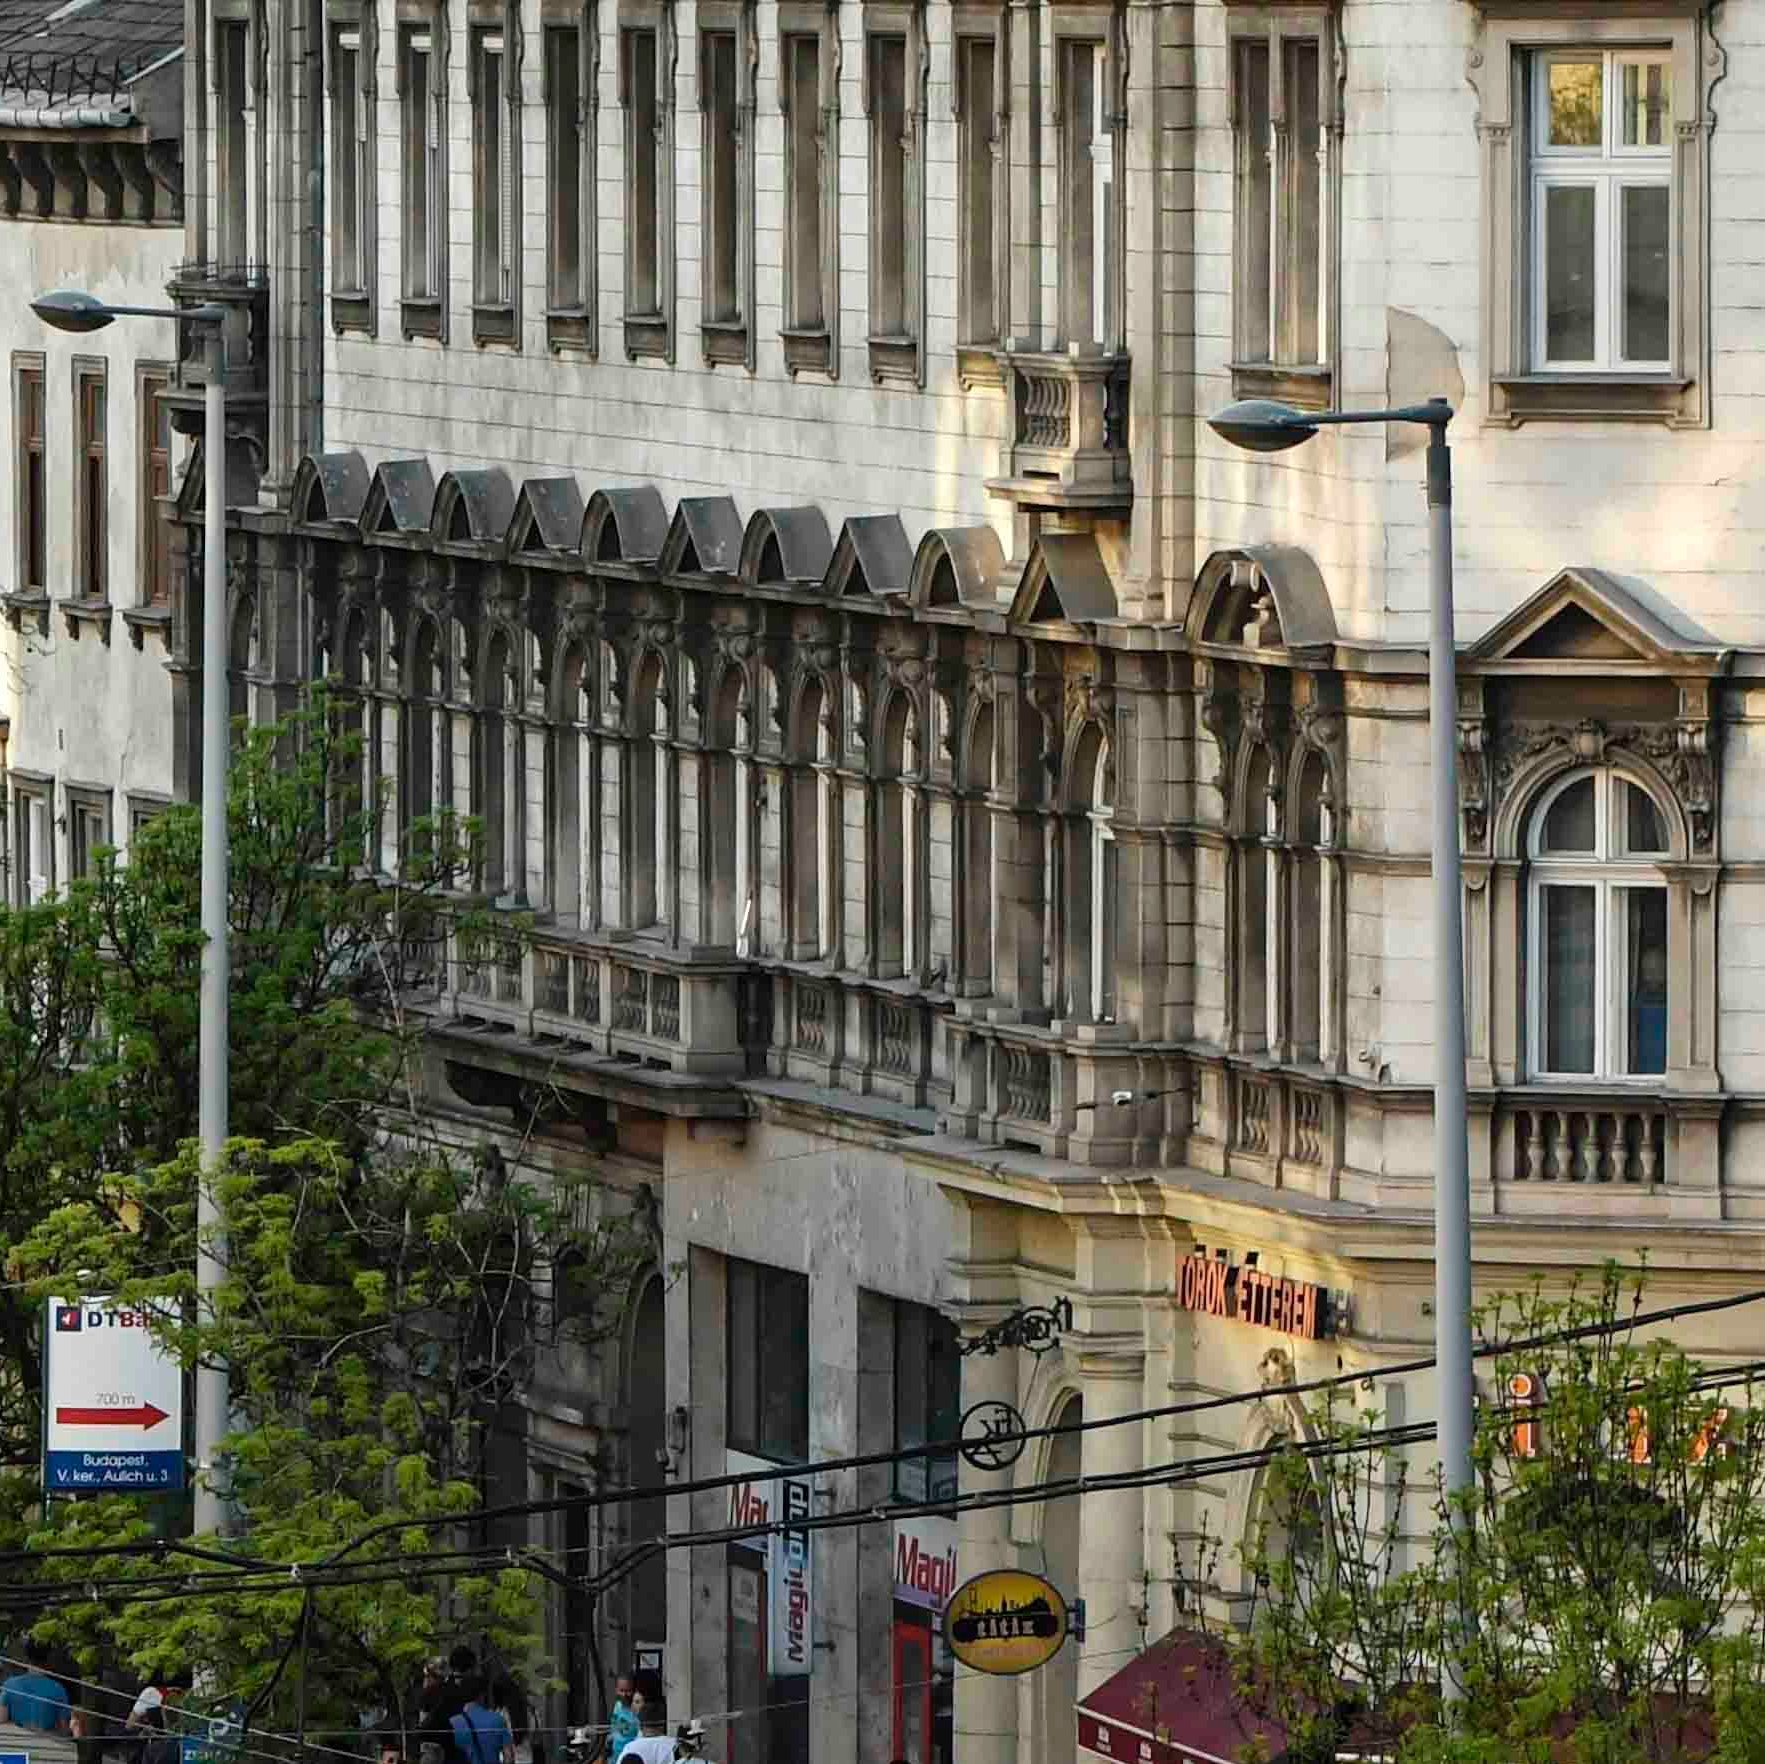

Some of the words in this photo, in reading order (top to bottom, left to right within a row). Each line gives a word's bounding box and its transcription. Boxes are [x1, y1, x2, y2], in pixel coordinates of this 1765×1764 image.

[83, 1453, 149, 1468] Budapest,
[57, 1470, 70, 1481] V.
[146, 1472, 157, 1482] u.
